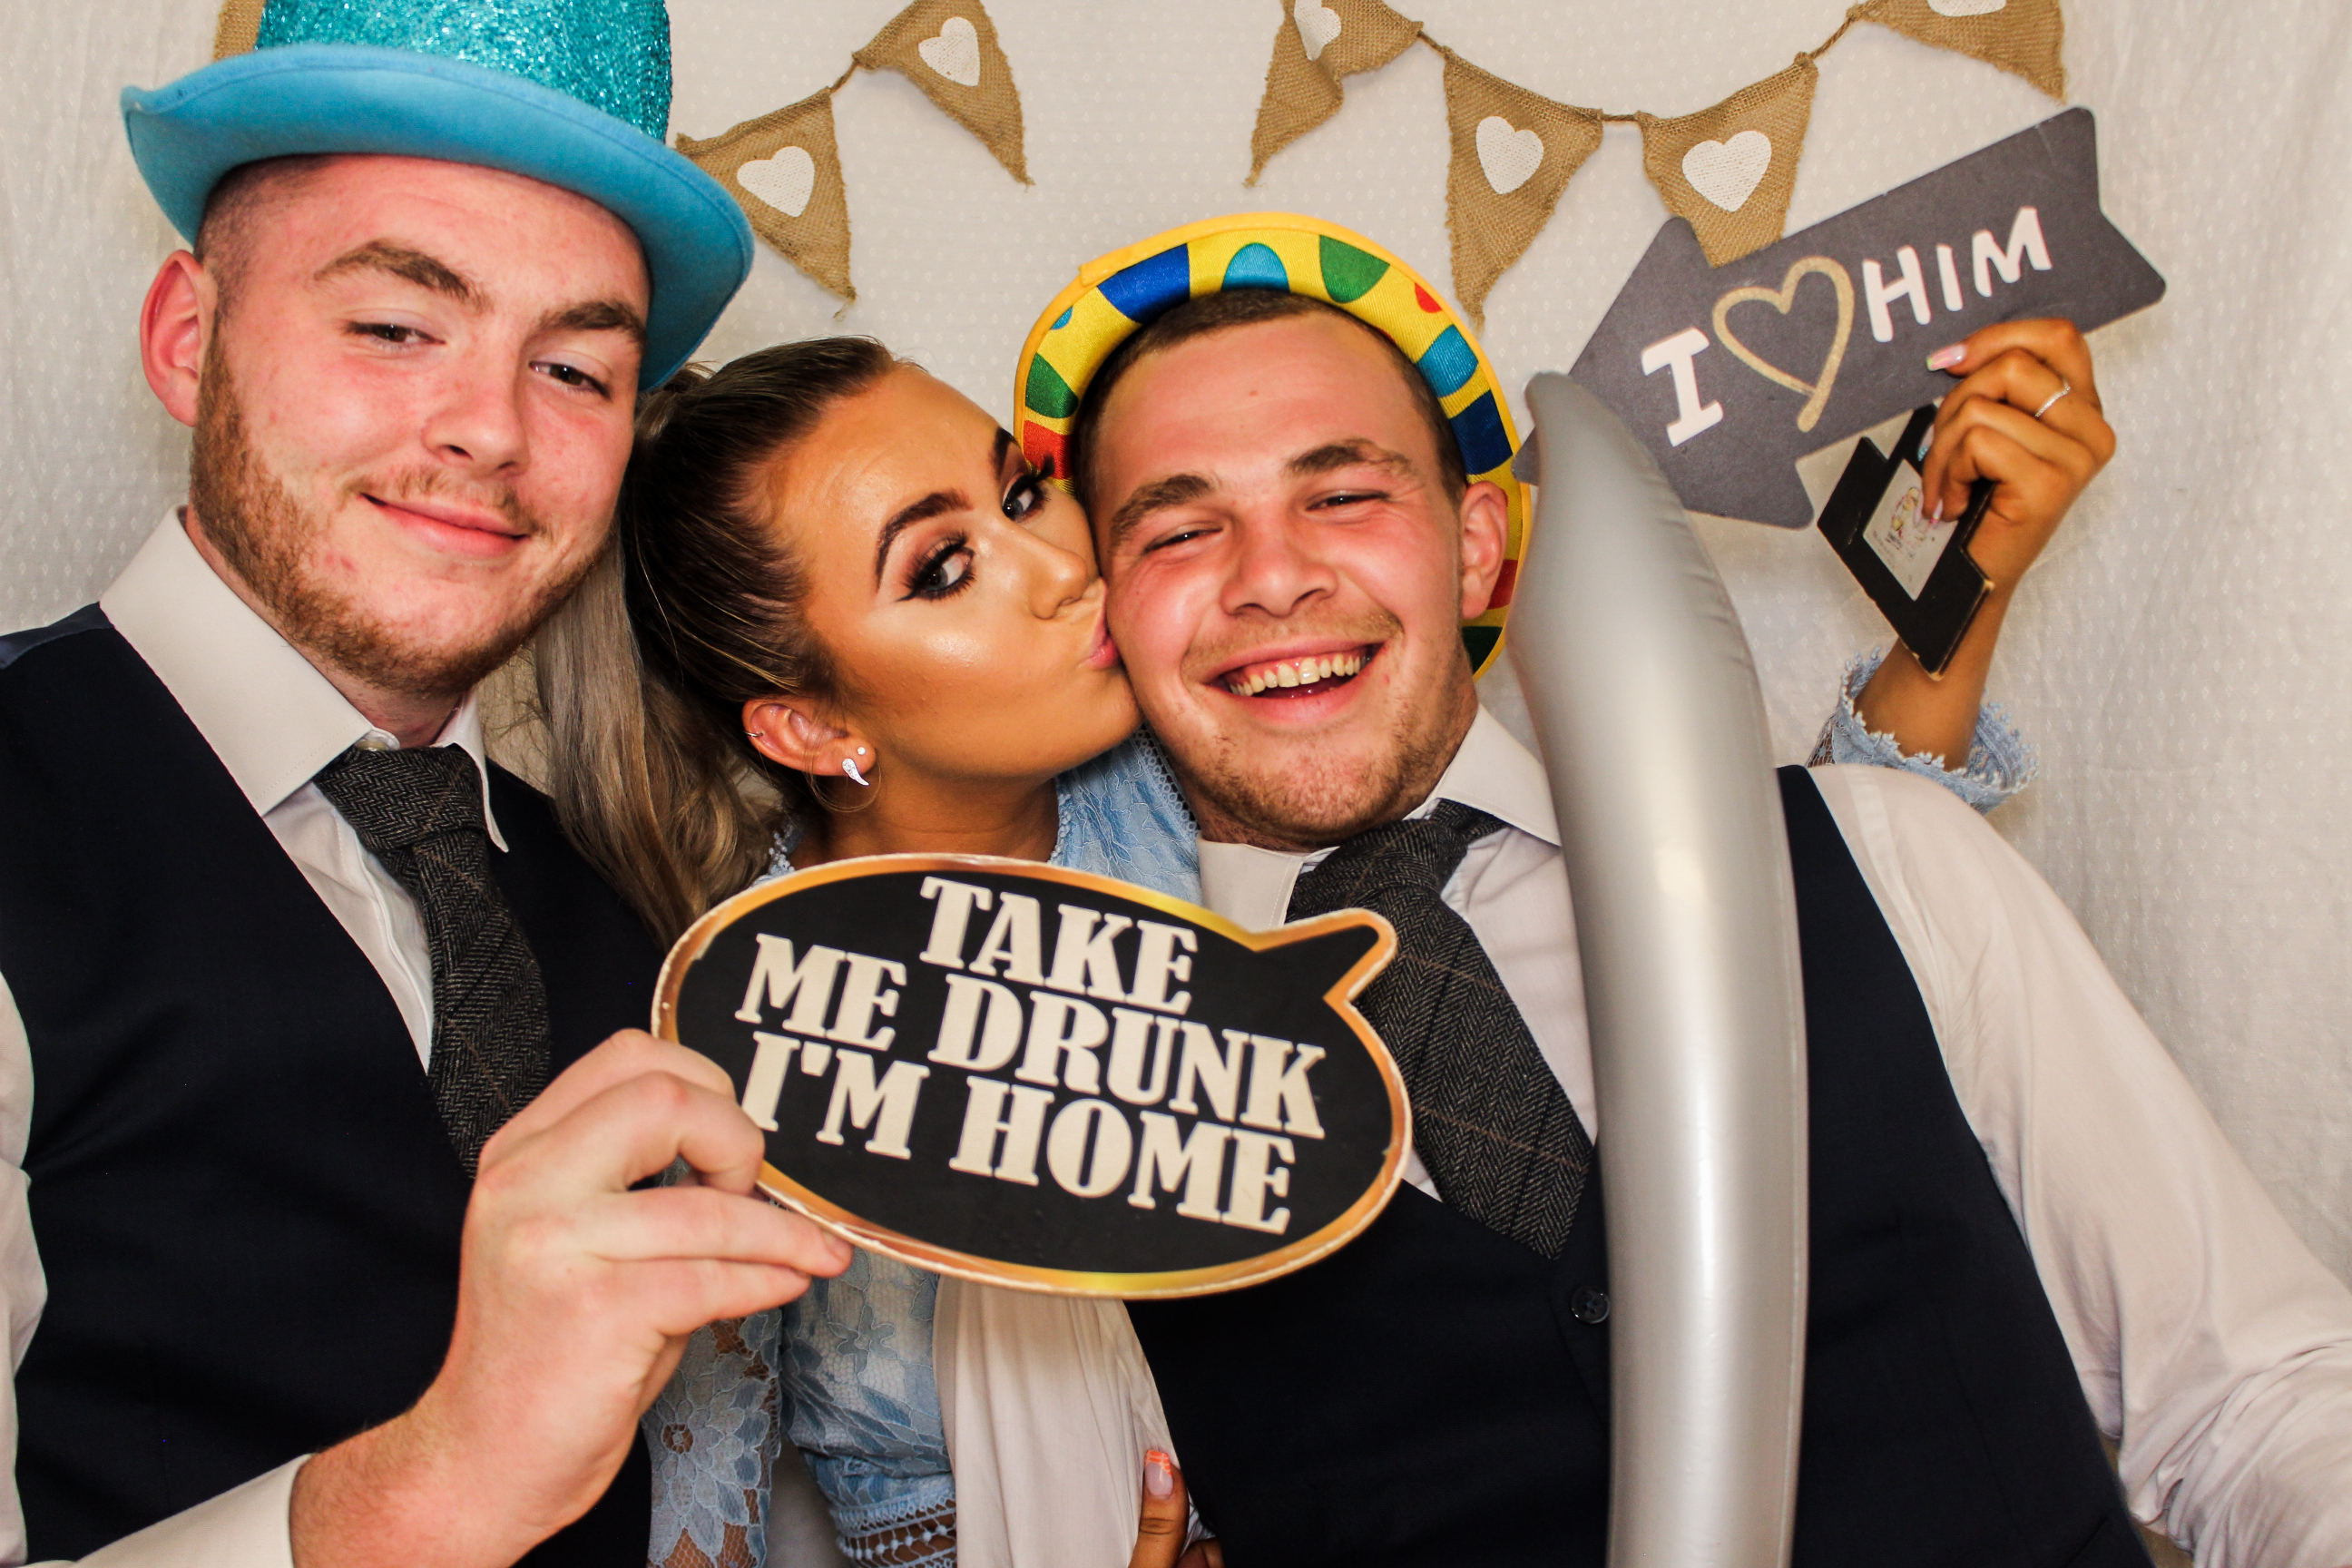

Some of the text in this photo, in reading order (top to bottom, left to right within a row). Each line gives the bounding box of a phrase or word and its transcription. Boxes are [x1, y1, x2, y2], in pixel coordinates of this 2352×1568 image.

[1641, 206, 2052, 446] I HIM
[735, 933, 1326, 1139] ME DRUNK
[920, 876, 1198, 1014] TAKE
[741, 1031, 1295, 1235] I'M HOME
